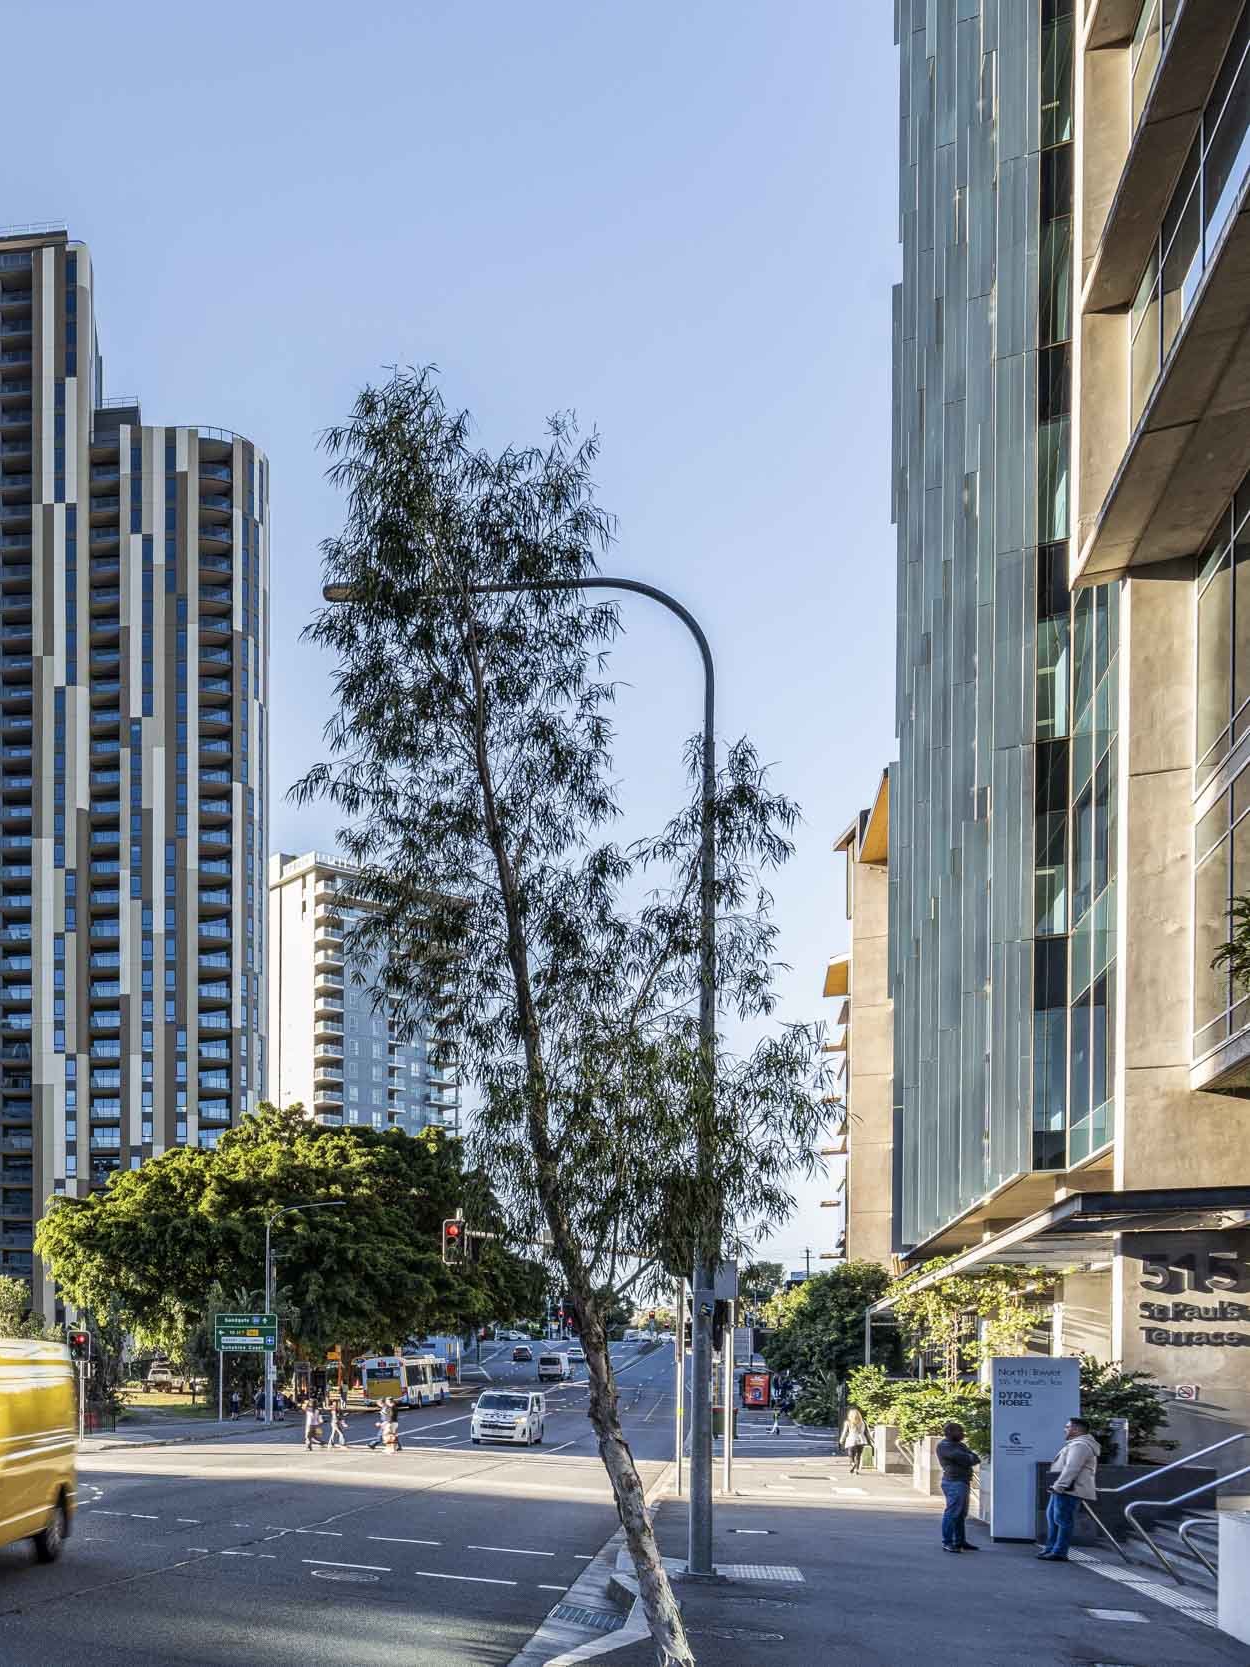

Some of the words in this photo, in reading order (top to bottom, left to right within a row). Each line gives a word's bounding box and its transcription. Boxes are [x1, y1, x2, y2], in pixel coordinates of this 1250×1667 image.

[1138, 1252, 1238, 1293] 515
[1139, 1301, 1164, 1319] St
[1169, 1300, 1240, 1320] Paul's
[1139, 1326, 1239, 1344] Terrace
[998, 1367, 1028, 1377] North
[1030, 1368, 1061, 1377] Tower
[998, 1391, 1032, 1399] DYNO
[998, 1399, 1033, 1407] NOBEL
